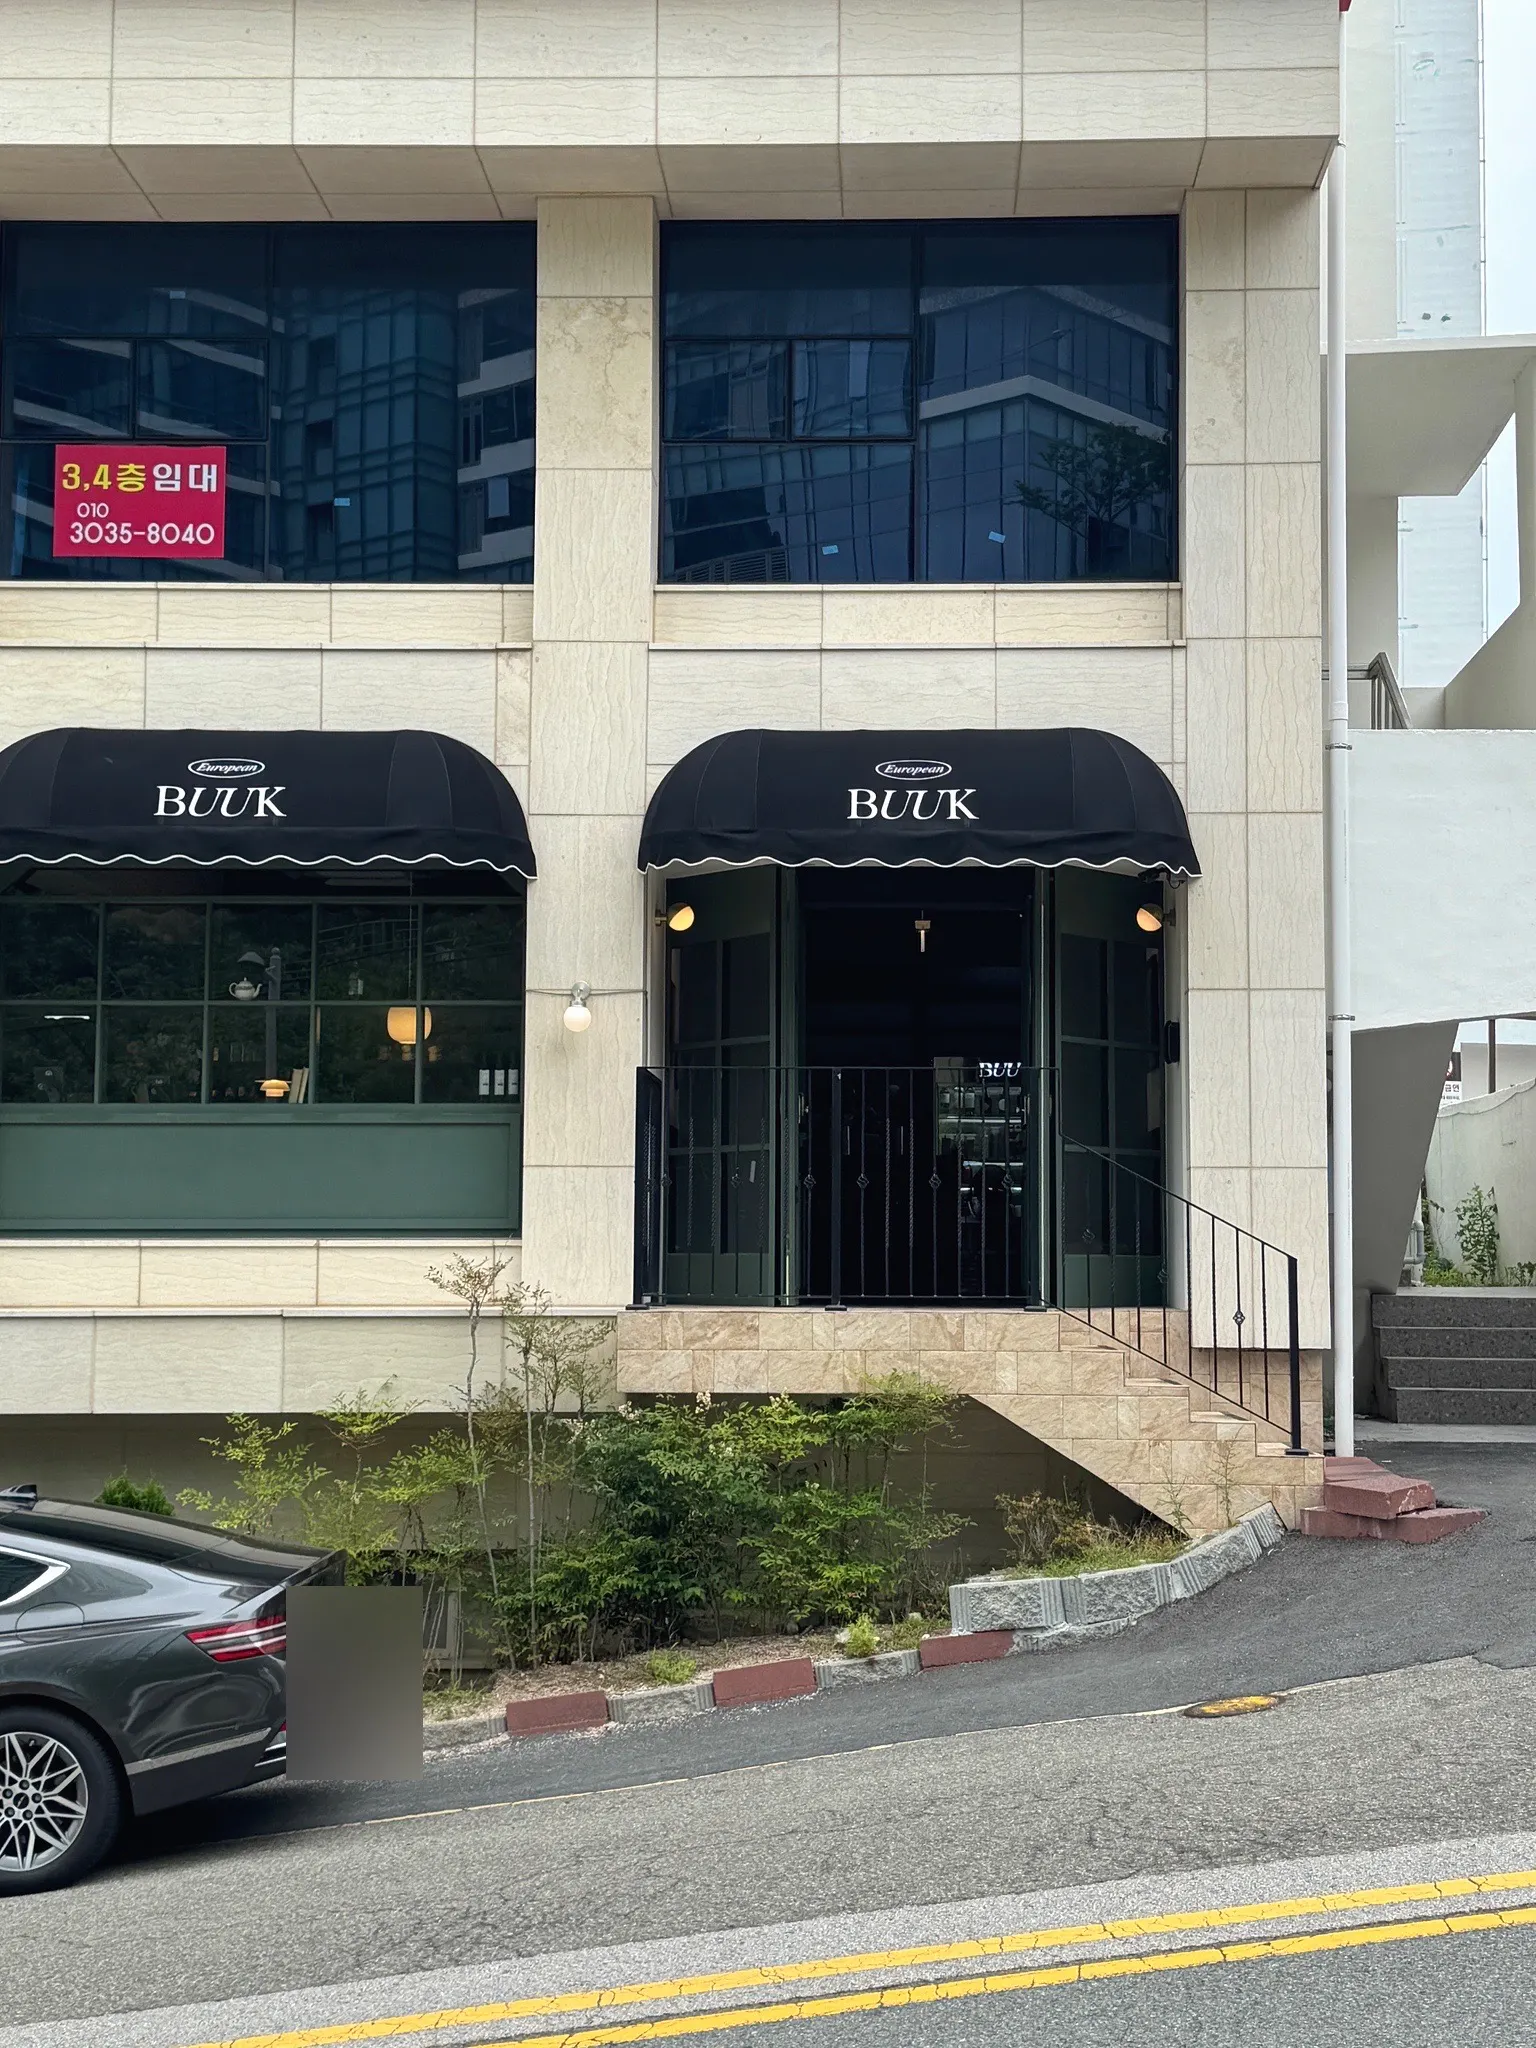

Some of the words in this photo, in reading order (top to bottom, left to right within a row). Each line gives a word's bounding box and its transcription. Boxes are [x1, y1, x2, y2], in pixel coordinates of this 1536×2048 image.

[76, 502, 110, 519] 010
[69, 521, 216, 545] 3035-8040
[196, 762, 259, 774] European
[883, 764, 946, 776] European
[153, 785, 288, 818] BUUK
[846, 788, 980, 820] BUUK
[979, 1062, 1022, 1078] BUU
